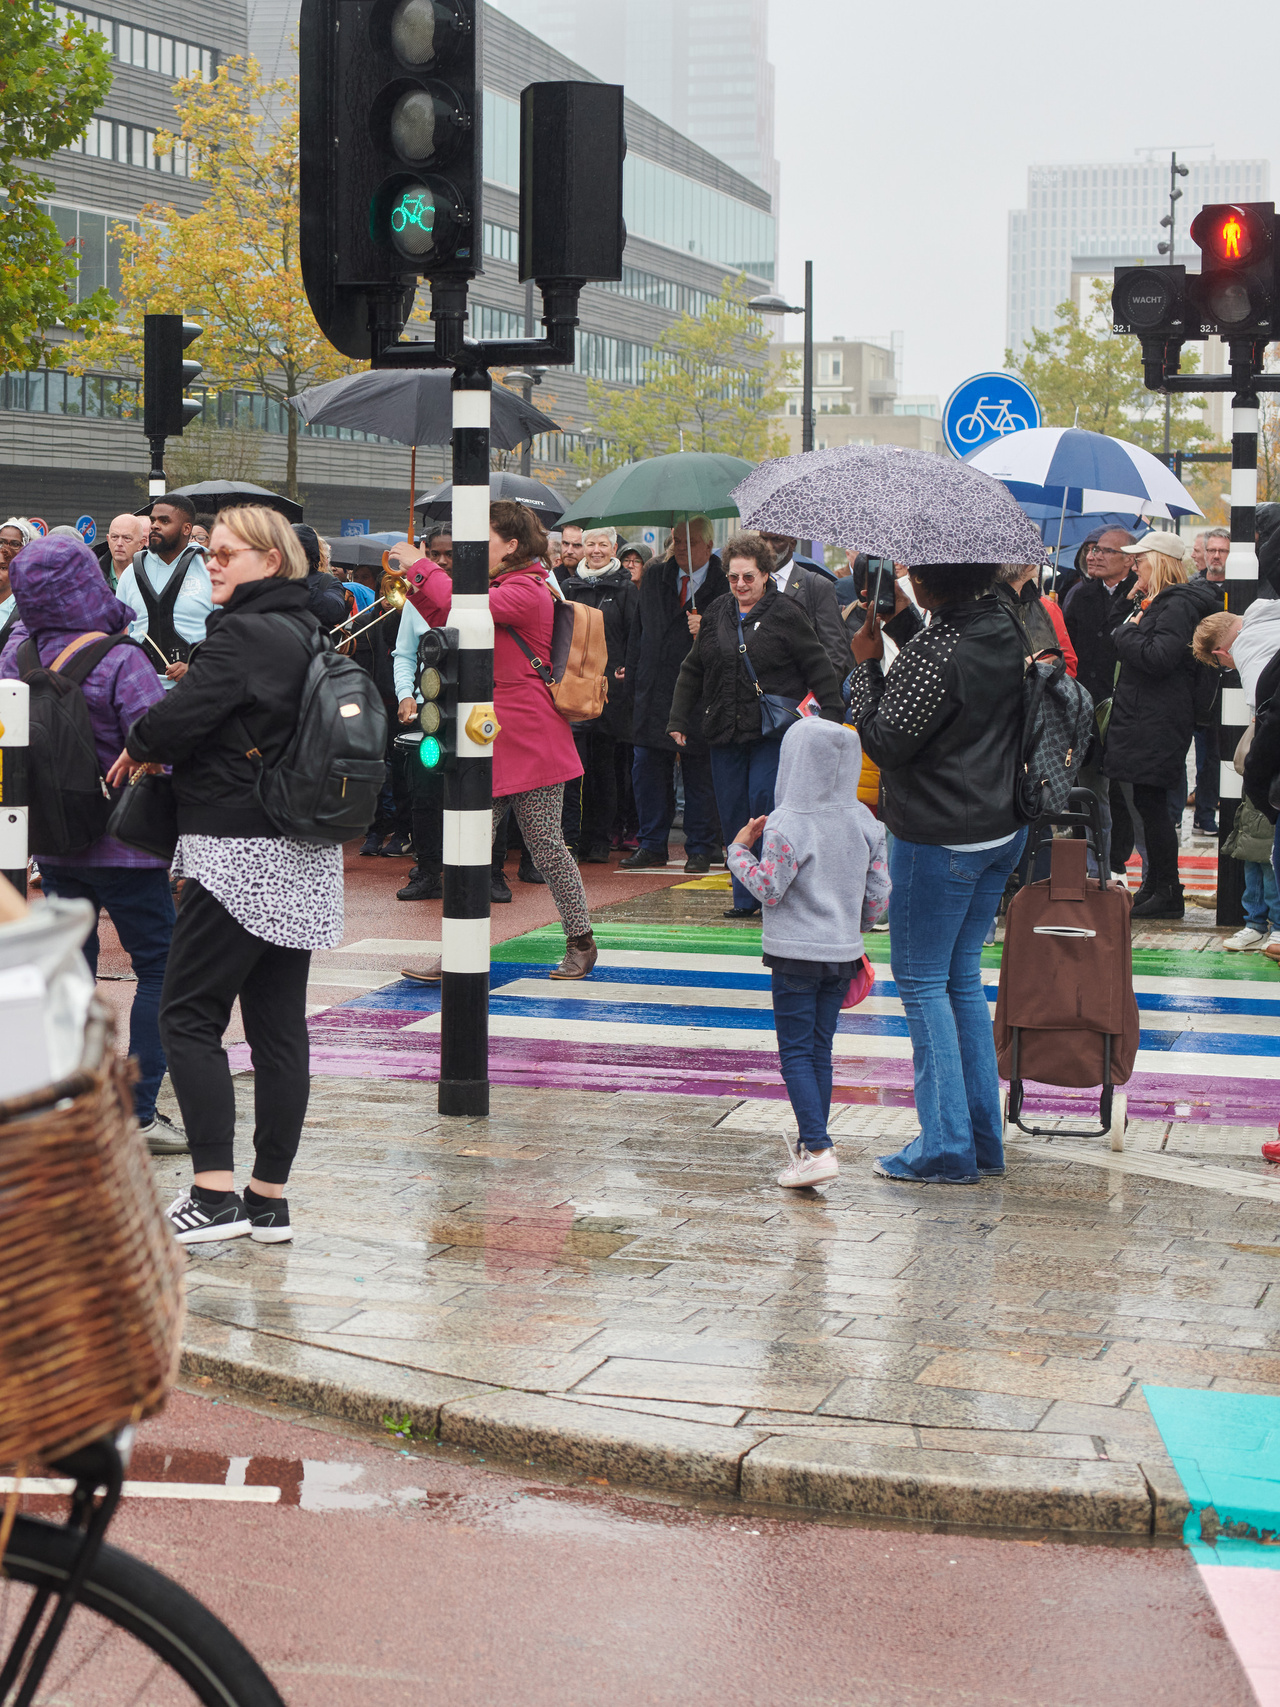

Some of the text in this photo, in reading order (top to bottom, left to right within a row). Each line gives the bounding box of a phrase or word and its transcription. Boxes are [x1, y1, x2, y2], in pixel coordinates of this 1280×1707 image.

[1030, 172, 1062, 185] Regus
[1132, 296, 1162, 304] WACHT
[1113, 324, 1131, 333] 32.1
[1200, 324, 1218, 333] 32.1
